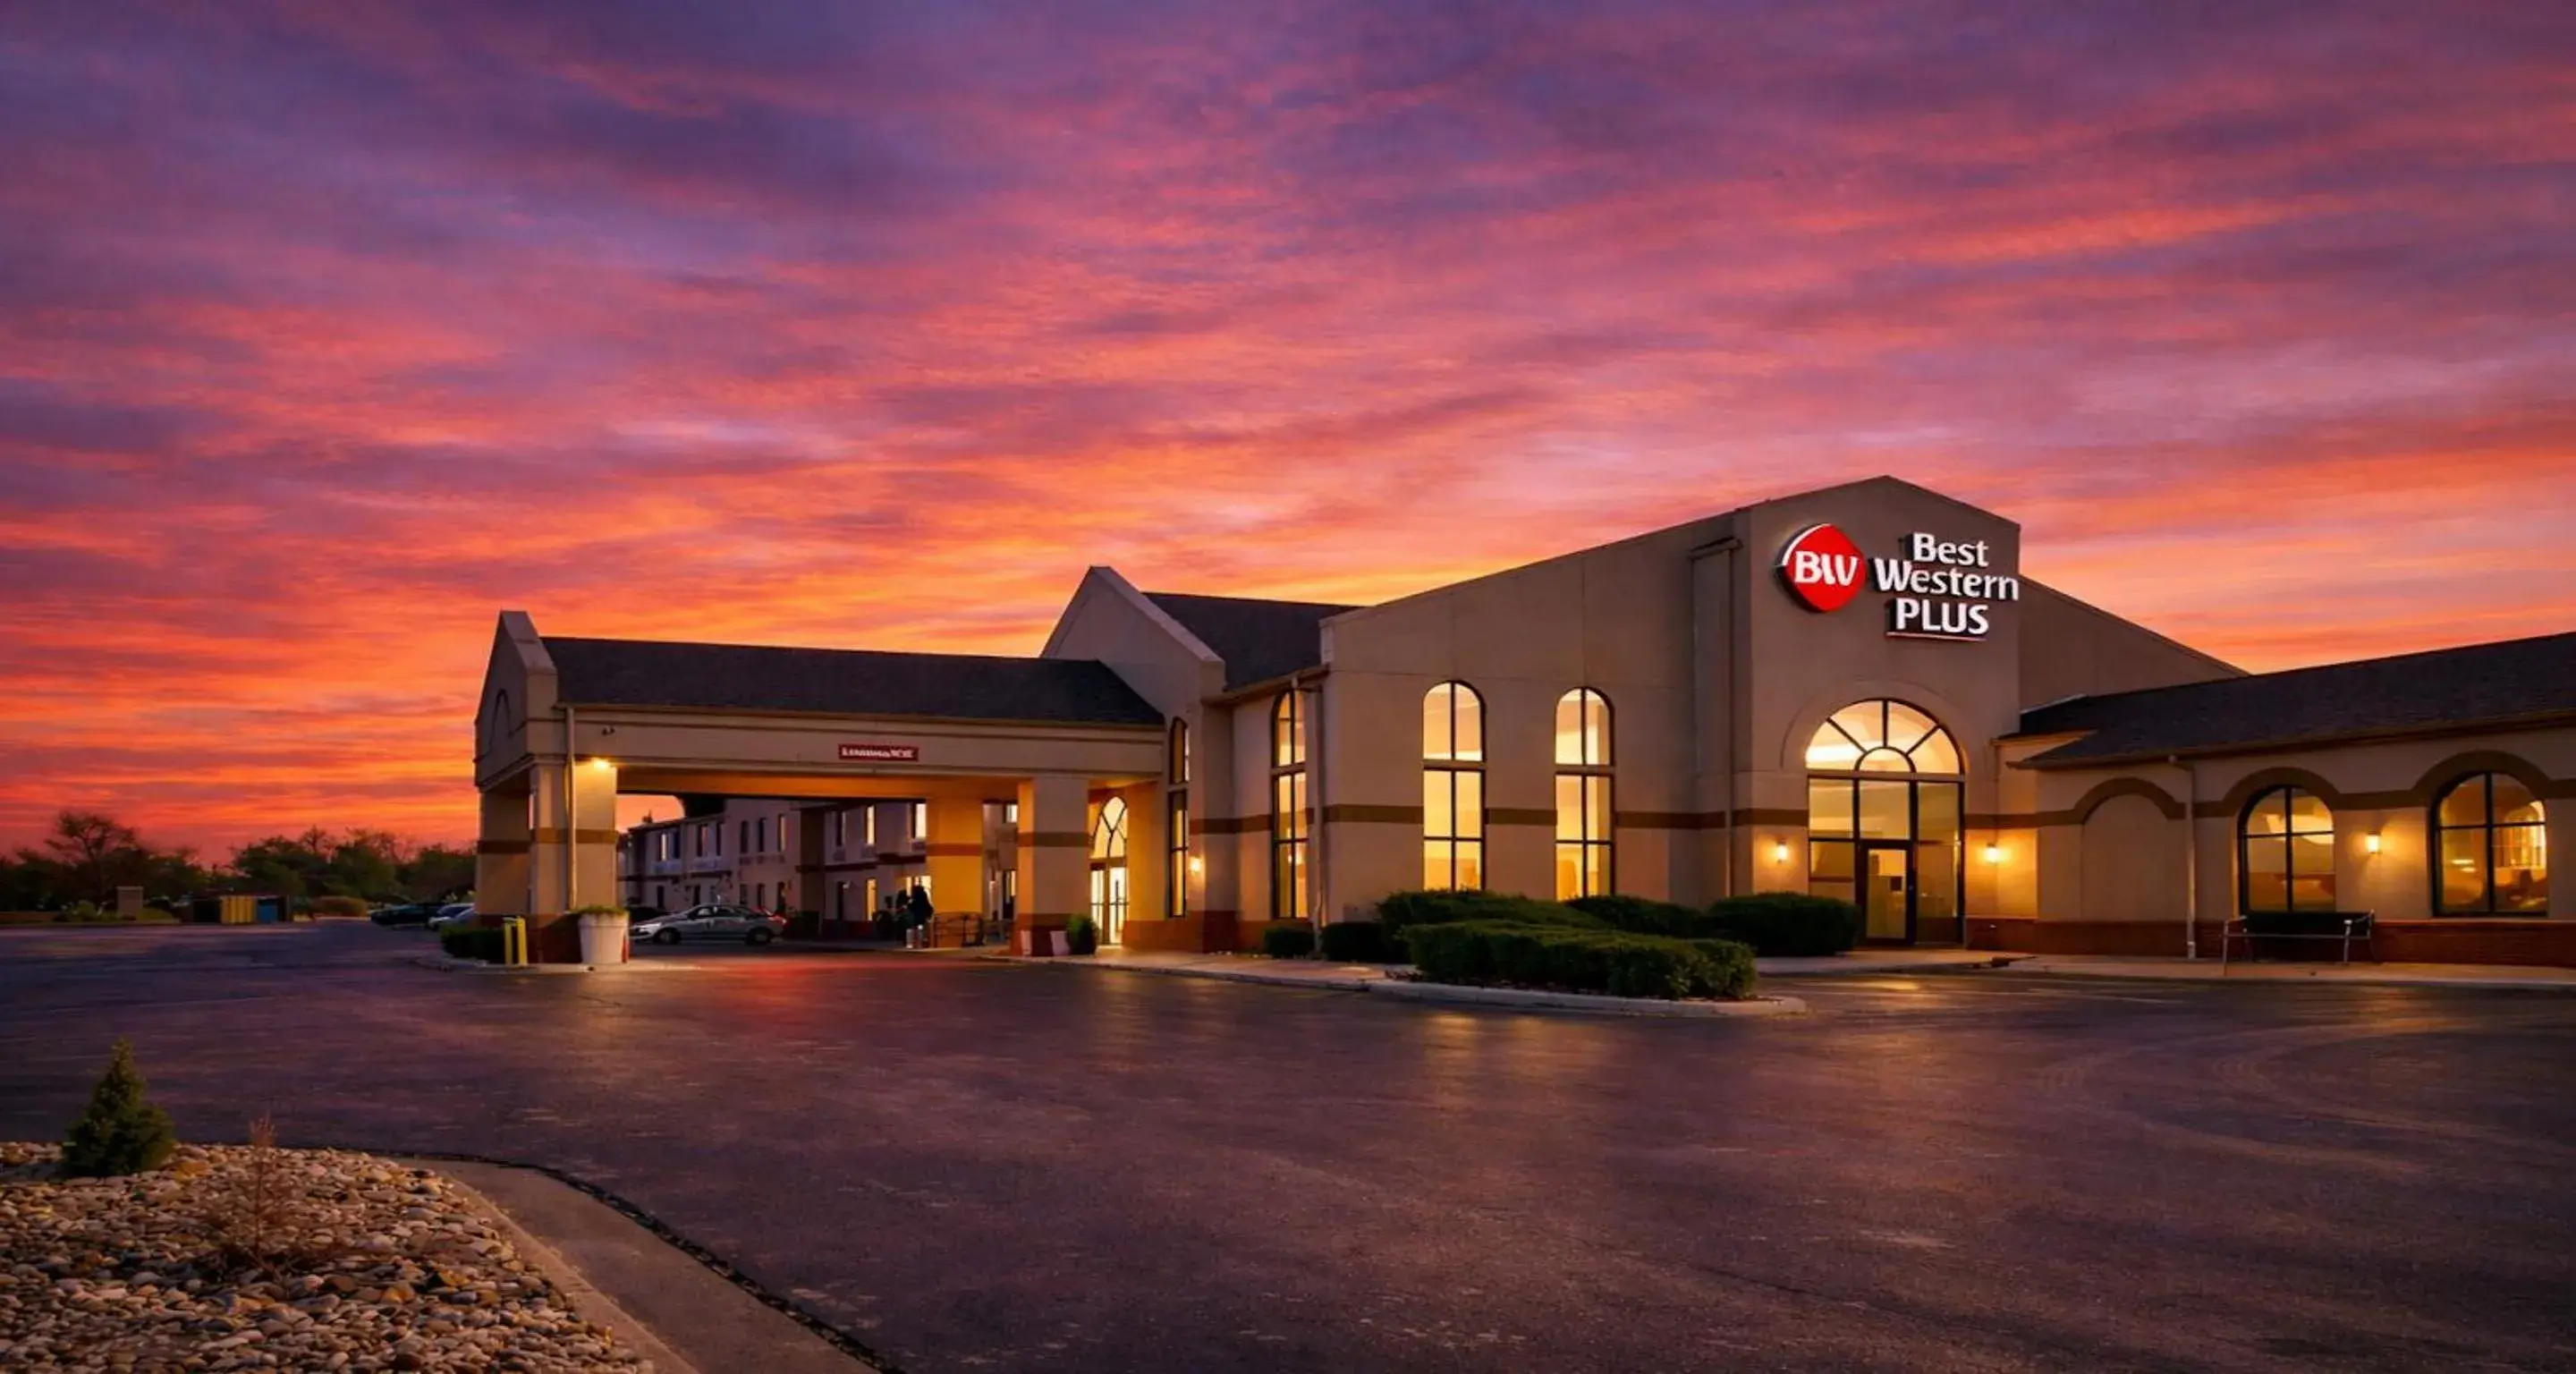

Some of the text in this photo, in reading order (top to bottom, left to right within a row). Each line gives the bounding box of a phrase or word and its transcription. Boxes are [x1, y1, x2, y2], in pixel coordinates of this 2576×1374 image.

[1912, 532, 1989, 567] Best
[1794, 551, 1858, 586] BW
[1874, 558, 2019, 600] Western
[1896, 598, 1989, 634] PLUS
